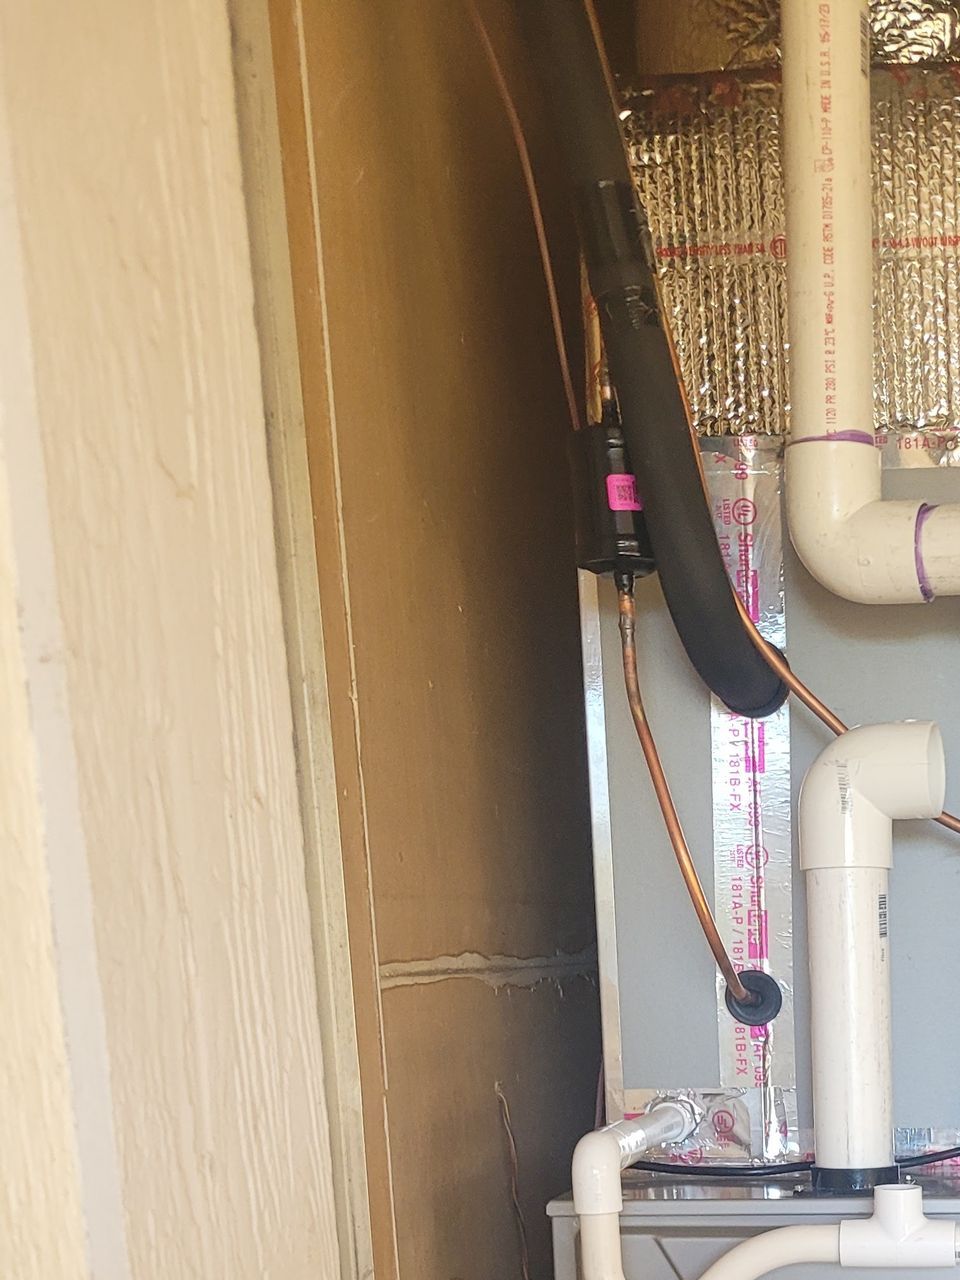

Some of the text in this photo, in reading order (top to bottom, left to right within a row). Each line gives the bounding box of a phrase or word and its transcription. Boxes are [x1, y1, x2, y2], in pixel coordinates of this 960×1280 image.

[819, 80, 831, 88] IN
[819, 96, 831, 112] MADE
[729, 753, 742, 811] 181B-FX
[736, 844, 744, 868] LISTED
[731, 877, 744, 925] 181A-P
